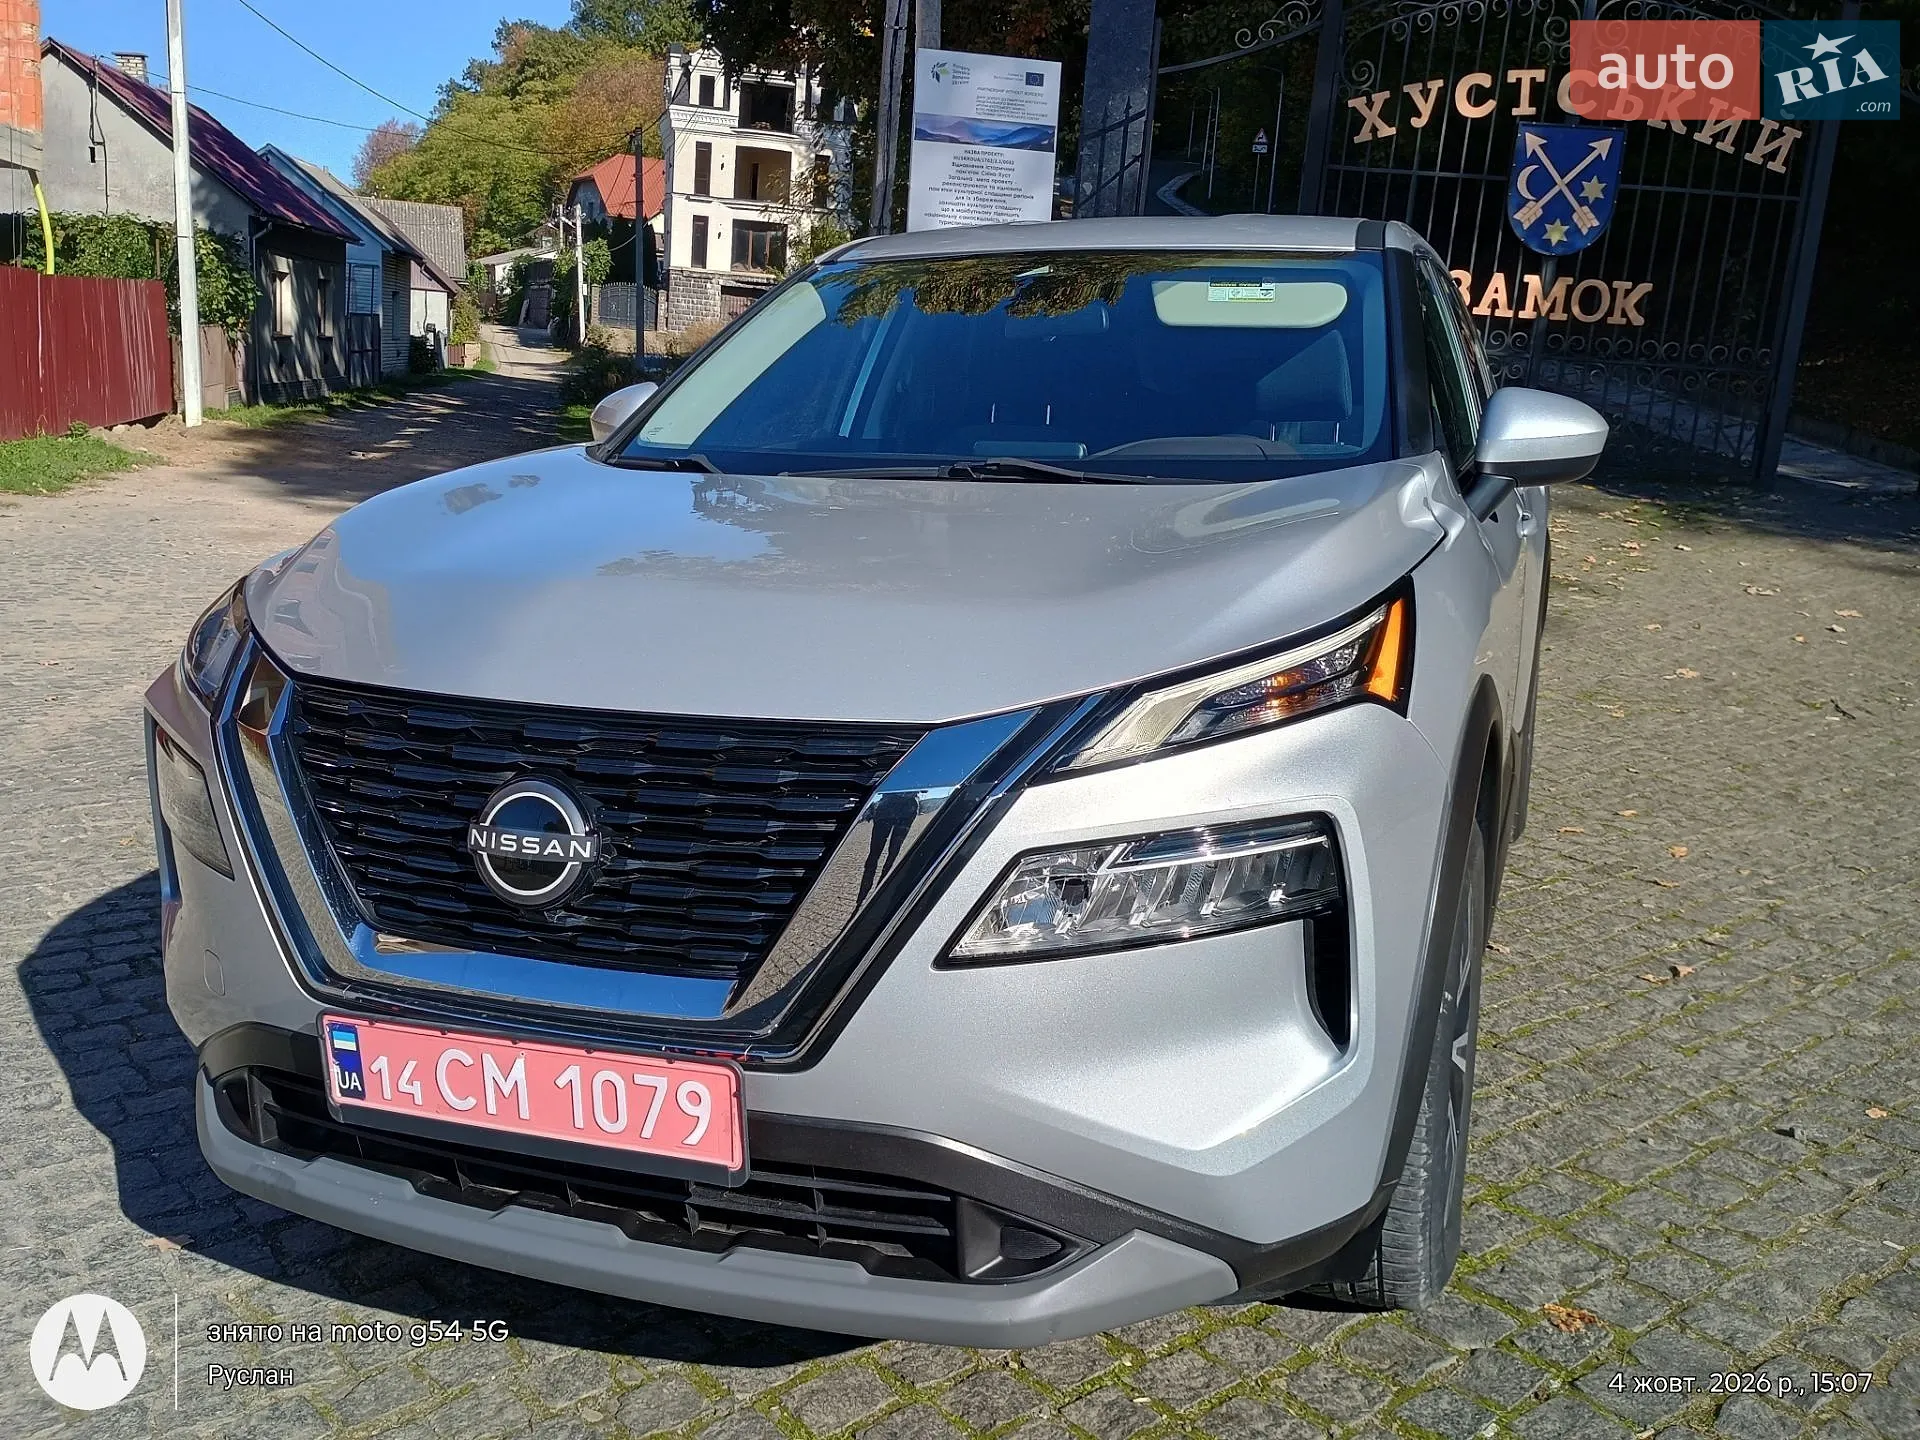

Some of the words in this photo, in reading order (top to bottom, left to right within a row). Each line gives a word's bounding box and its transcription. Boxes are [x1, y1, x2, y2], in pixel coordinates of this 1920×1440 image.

[1346, 68, 1803, 175] ХУСТСЬКИЙ
[470, 828, 592, 858] NISSAN
[337, 1069, 362, 1092] UA
[369, 1055, 423, 1106] 14
[554, 1064, 712, 1146] 1079
